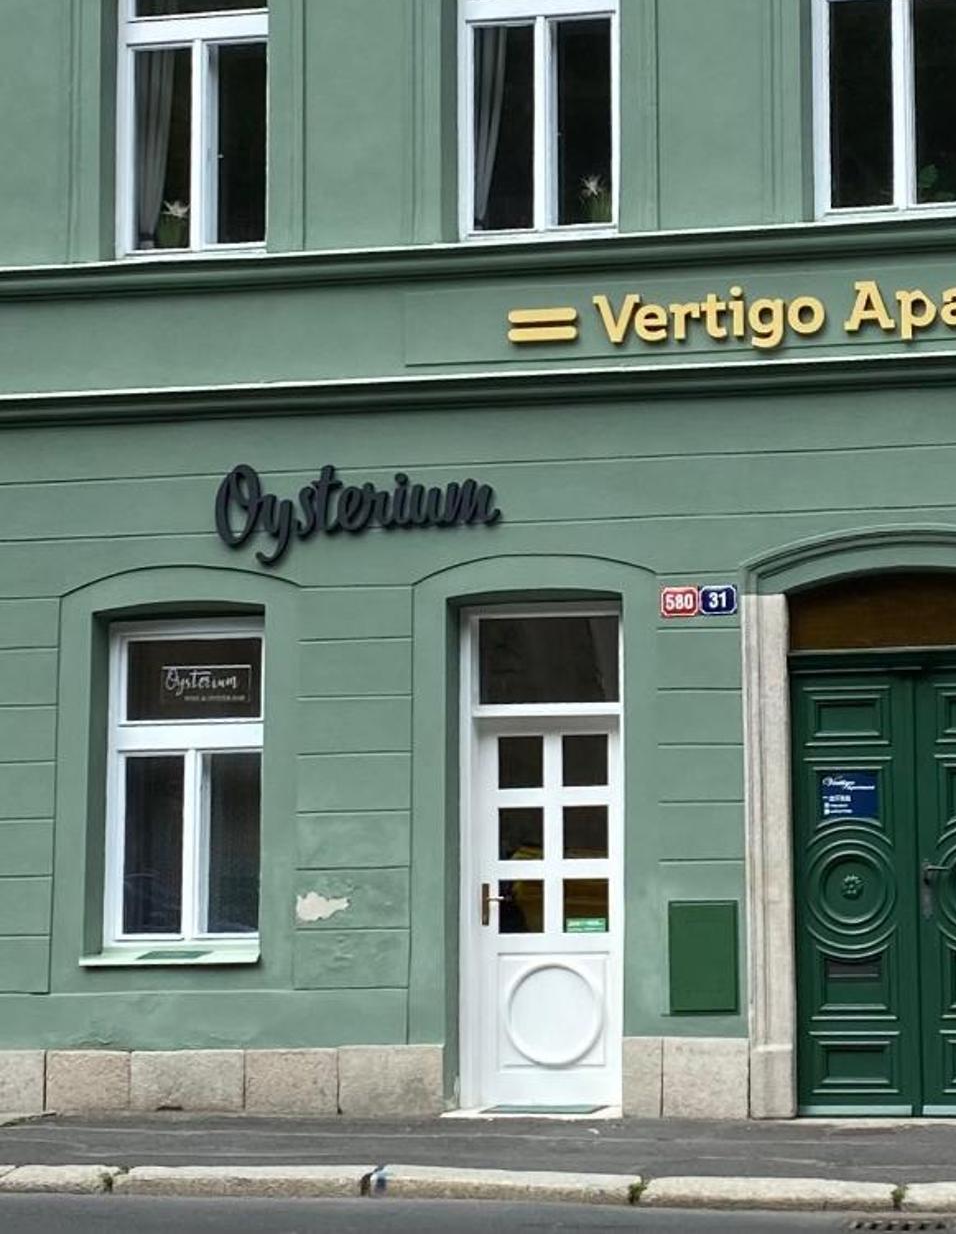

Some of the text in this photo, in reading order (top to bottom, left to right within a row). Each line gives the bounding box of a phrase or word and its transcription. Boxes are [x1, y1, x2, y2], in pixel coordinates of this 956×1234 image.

[593, 286, 826, 350] Vertigo
[215, 464, 502, 566] Oysterium
[665, 593, 694, 611] 580
[708, 591, 727, 609] 31
[165, 667, 237, 696] Oysterium
